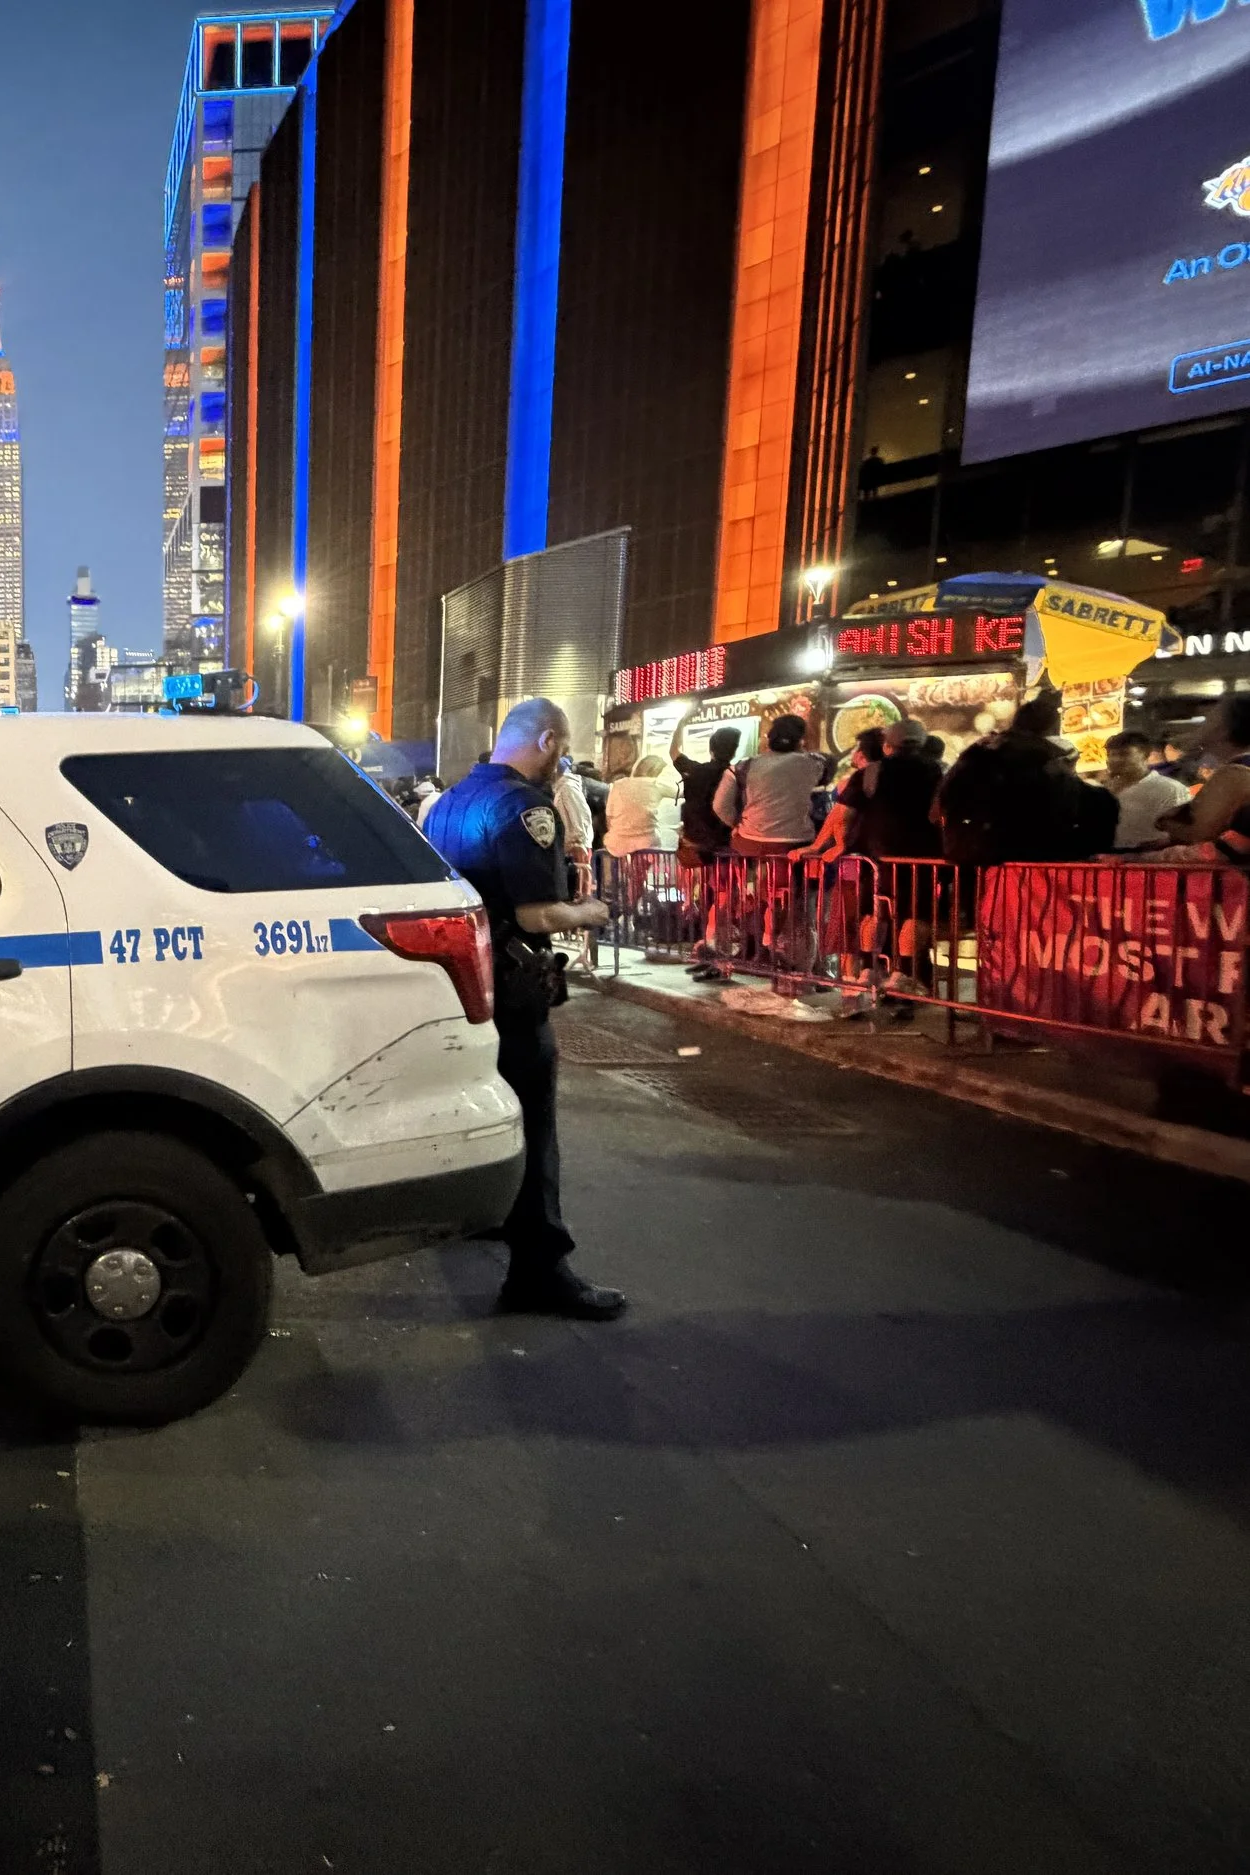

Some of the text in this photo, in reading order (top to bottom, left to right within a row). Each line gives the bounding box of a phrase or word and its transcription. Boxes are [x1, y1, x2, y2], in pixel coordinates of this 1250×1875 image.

[1163, 258, 1212, 284] An
[1049, 594, 1156, 635] SABRETT
[720, 701, 750, 718] FOOD
[109, 925, 204, 964] 47 PCT
[1020, 930, 1199, 989] MOST
